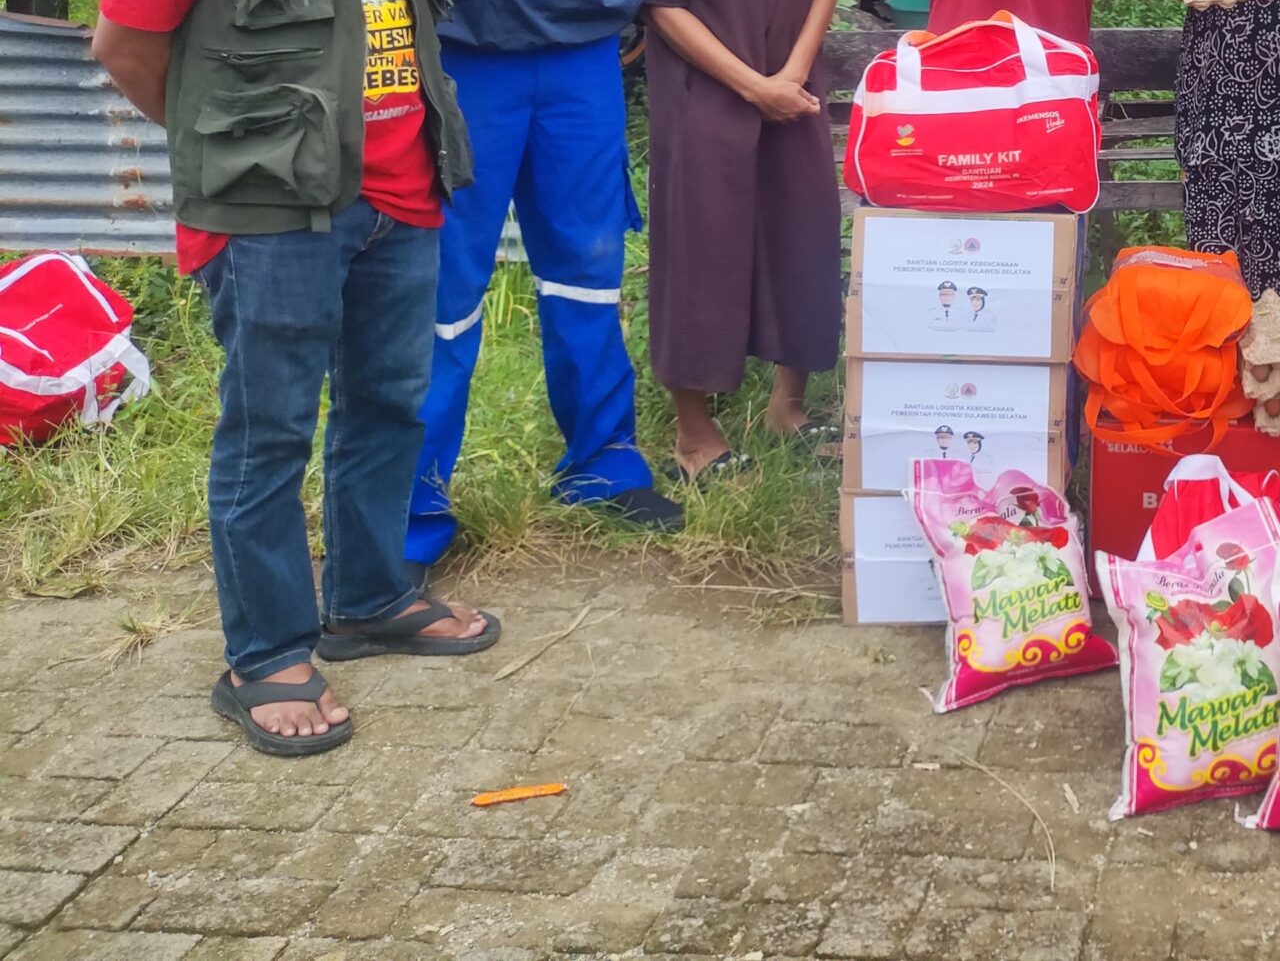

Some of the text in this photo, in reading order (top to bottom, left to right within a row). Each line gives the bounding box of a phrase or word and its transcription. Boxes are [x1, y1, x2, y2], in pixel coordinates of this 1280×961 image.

[937, 152, 994, 167] FAMILY
[997, 149, 1022, 164] KIT
[961, 167, 1002, 176] BANTUAN
[971, 181, 994, 189] 2024
[972, 576, 1067, 624] Mawar
[1003, 592, 1082, 639] Melati
[1157, 685, 1267, 736] Mawar
